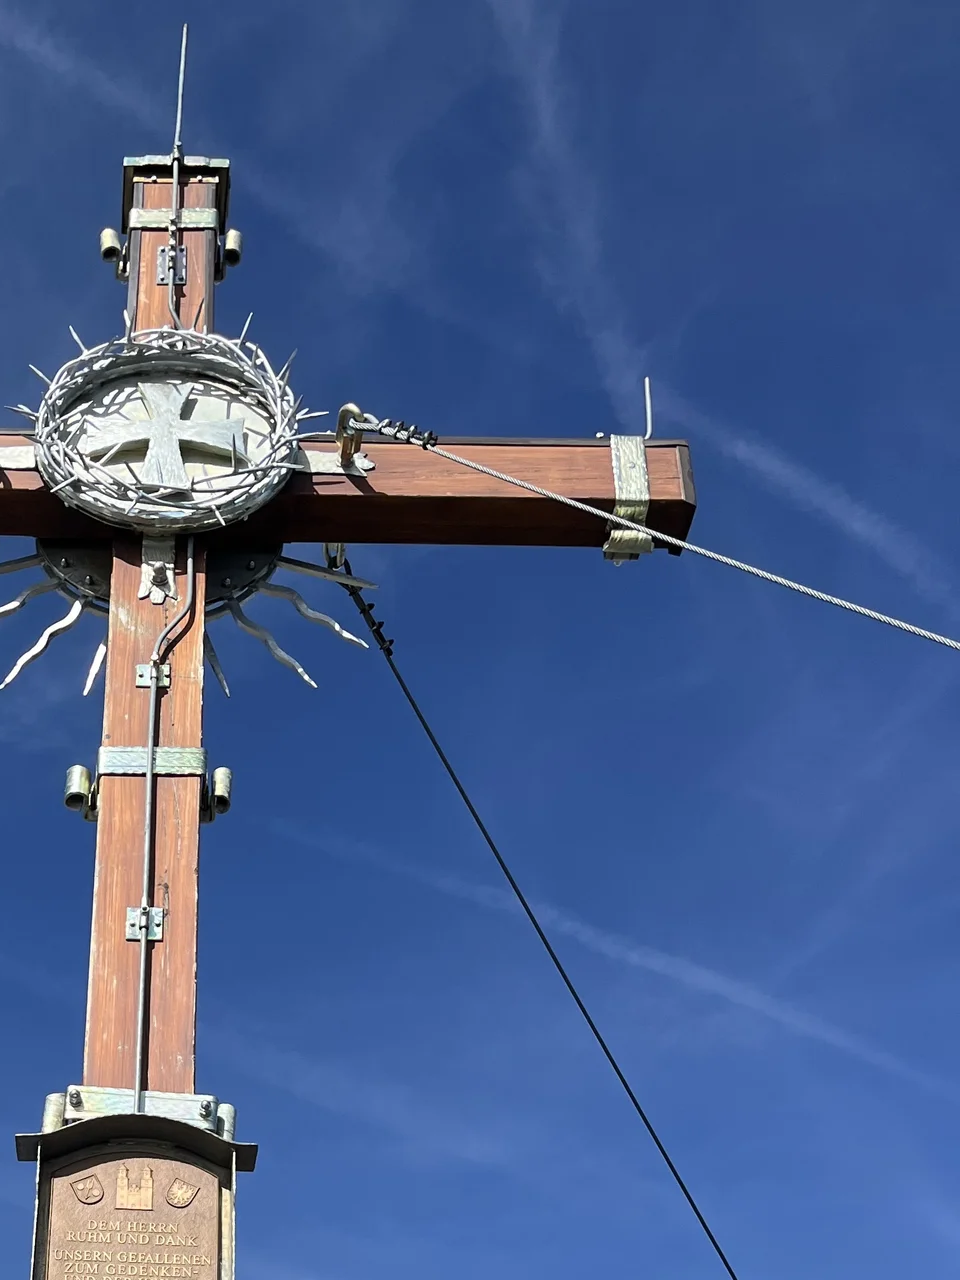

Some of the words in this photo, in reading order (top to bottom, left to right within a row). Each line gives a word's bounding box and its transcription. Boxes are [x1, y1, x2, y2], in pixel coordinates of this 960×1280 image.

[87, 1220, 121, 1231] DEM
[127, 1221, 179, 1233] HERRN
[66, 1231, 112, 1244] RUHM
[117, 1233, 150, 1245] UND
[155, 1235, 198, 1247] DANK
[54, 1250, 112, 1262] UNSERN
[117, 1252, 212, 1266] GEFALLENEN
[64, 1263, 99, 1275] ZUM
